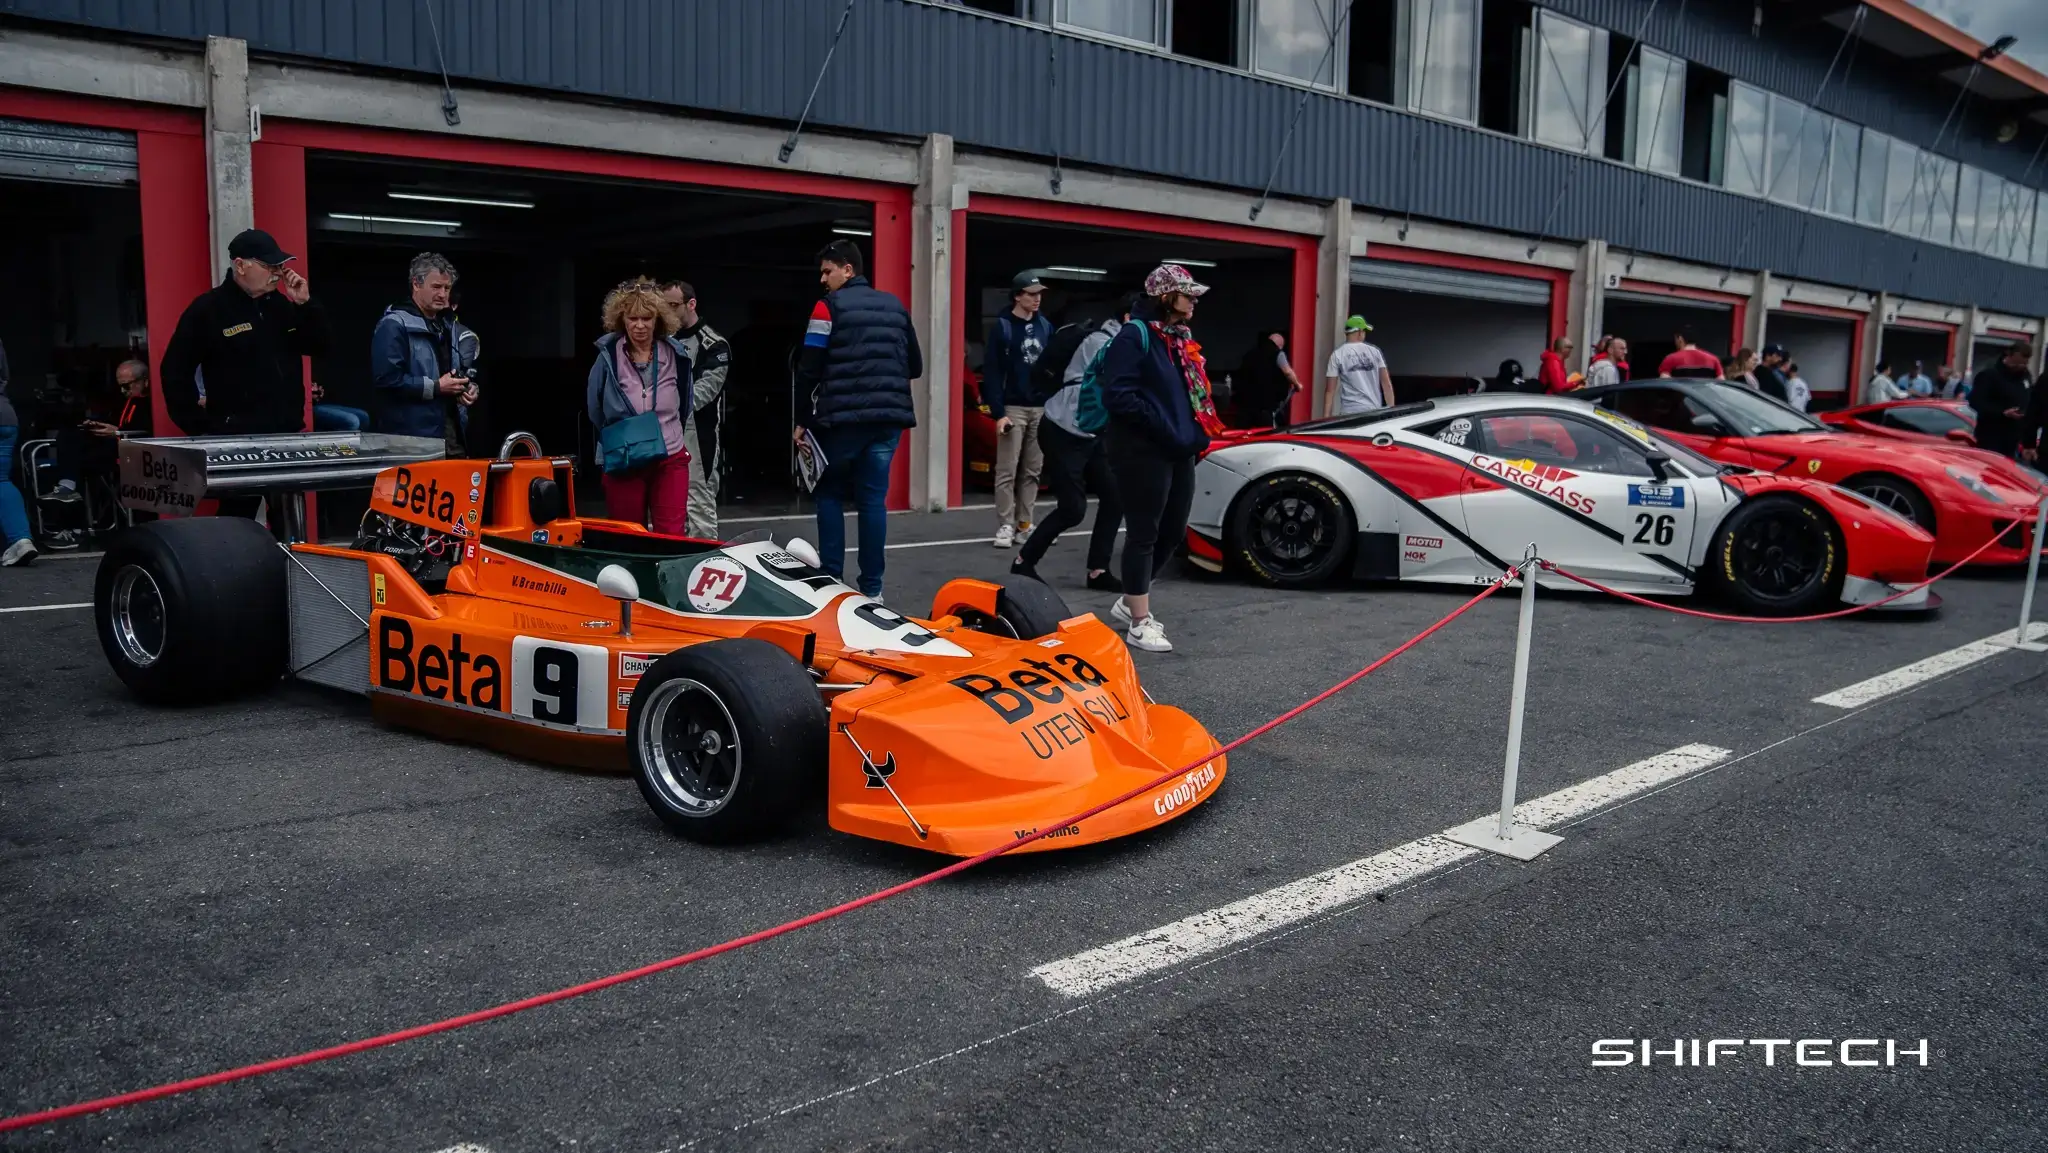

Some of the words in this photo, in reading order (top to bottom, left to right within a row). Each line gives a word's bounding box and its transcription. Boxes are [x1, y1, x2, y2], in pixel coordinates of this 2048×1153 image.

[1609, 274, 1617, 286] 5
[1439, 432, 1466, 445] 3464
[142, 451, 178, 481] Beta
[206, 449, 318, 462] GOODYEAR
[122, 484, 194, 508] GOODYEAR
[392, 467, 455, 523] Beta
[1472, 455, 1597, 514] CARGLASS
[1408, 537, 1441, 548] MOTUL
[1632, 512, 1675, 547] 26
[467, 545, 474, 558] E
[1404, 551, 1427, 560] NGK
[1723, 532, 1736, 581] PIRELLI
[512, 575, 567, 596] V.Brambilla
[689, 567, 743, 602] F1
[1474, 577, 1498, 585] SK
[854, 603, 937, 646] 9
[380, 616, 502, 712] Beta
[625, 662, 652, 671] CHAM
[532, 646, 579, 725] 9
[948, 654, 1109, 724] Beta
[1021, 692, 1130, 759] UTENSILI
[1154, 762, 1216, 816] GOODYEAR
